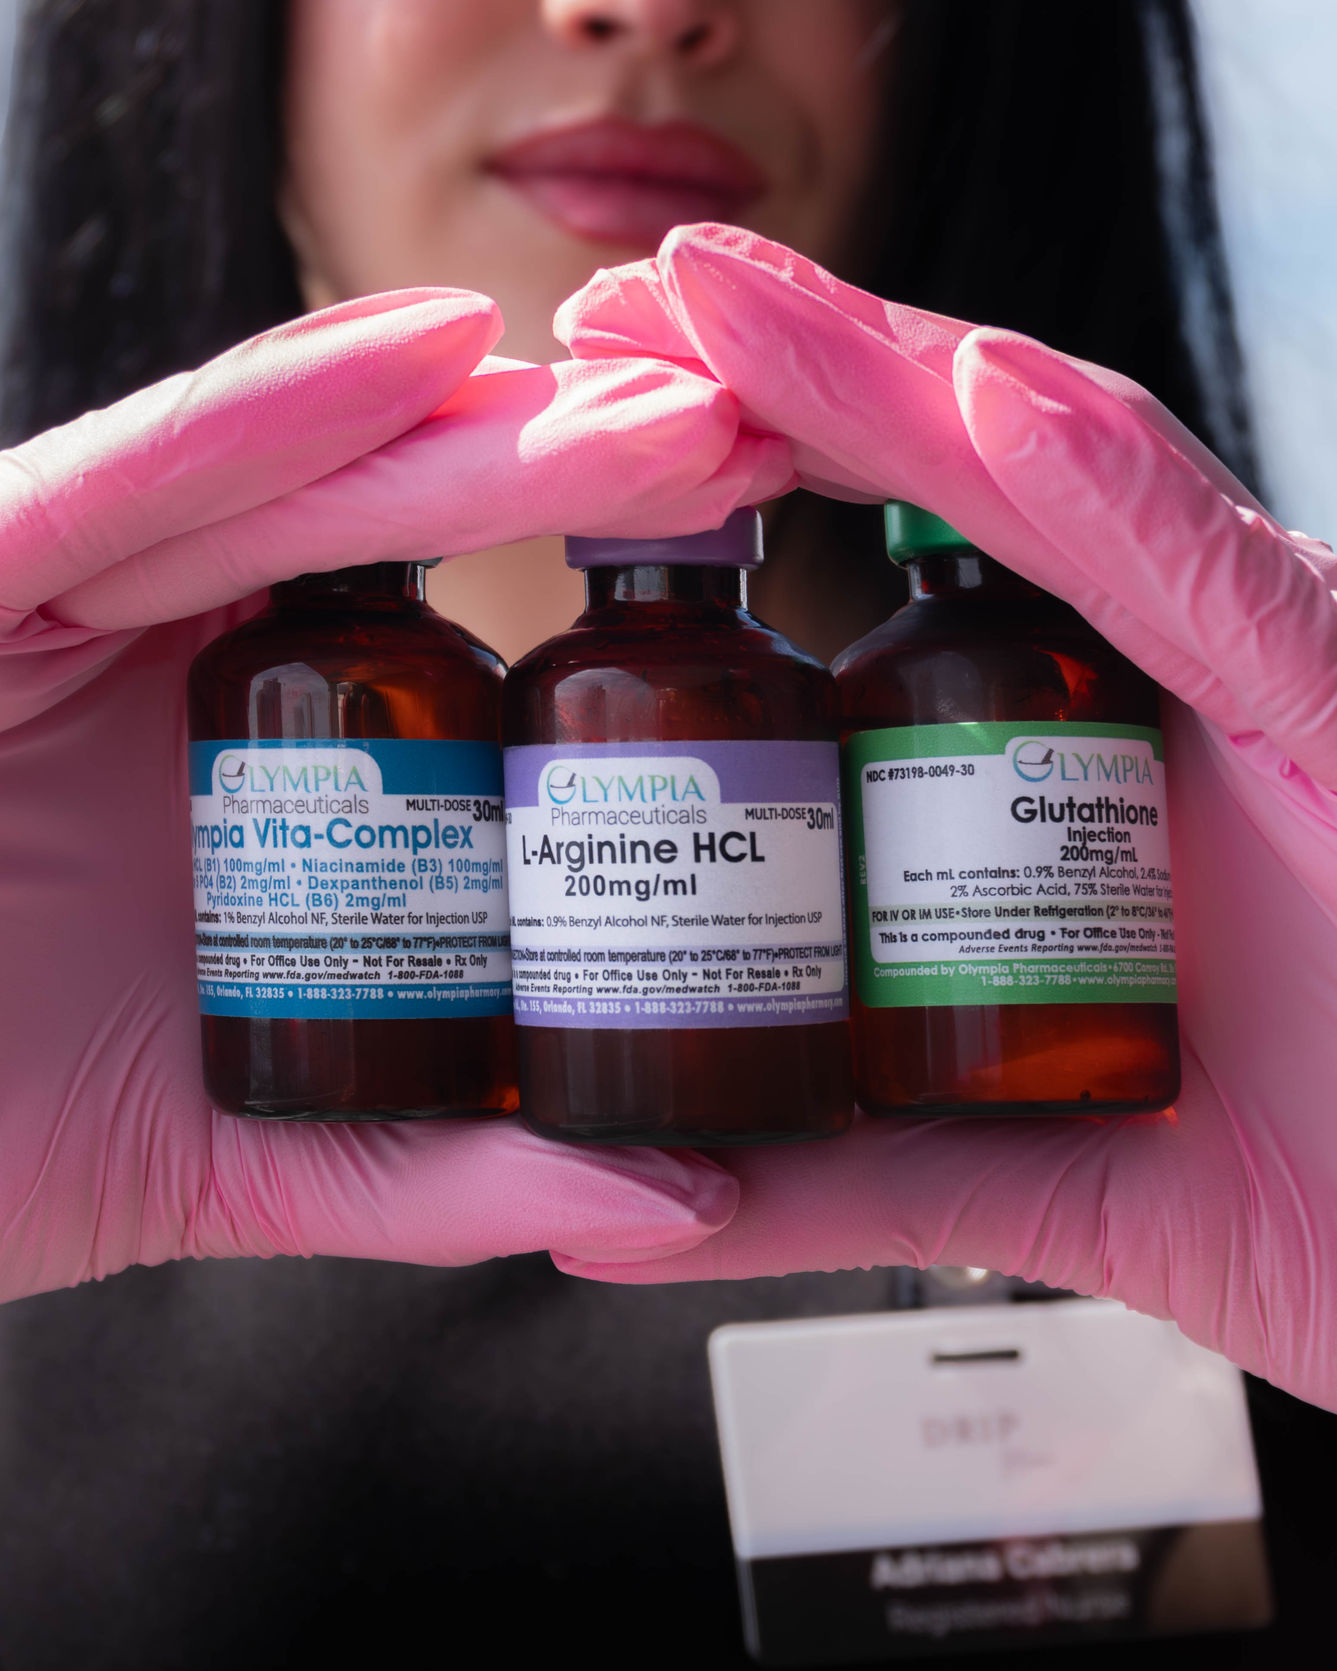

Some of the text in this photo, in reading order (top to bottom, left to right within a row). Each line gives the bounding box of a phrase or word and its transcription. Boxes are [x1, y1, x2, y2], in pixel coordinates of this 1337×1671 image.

[1012, 740, 1154, 785] OLYMPIA
[219, 754, 369, 794] OLYMPIA
[866, 764, 975, 783] NDC #73198-0049-30
[546, 766, 706, 805] OLYMPIA
[223, 794, 369, 814] Pharmaceuticals
[406, 799, 471, 812] MULTI-DOSE
[472, 799, 504, 822] 30ml
[1010, 796, 1158, 826] Glutathione
[551, 804, 707, 826] Pharmaceuticals
[745, 807, 835, 830] MULTI-DOSE 30ml
[191, 817, 474, 856] ympia Vita-Complex
[1067, 826, 1131, 846] Injection
[522, 831, 766, 873] L-Arginine HCL
[1060, 845, 1138, 865] 200mg/mL
[204, 857, 503, 876] (B1) 100mg/ml Niacinamide (B3) 100mg/ml
[903, 865, 1156, 882] Each mL contains: 0.9% Benzyl Alcohol, 2.4%
[216, 875, 503, 893] (B2) 2mg/ml Dexpanthenol (B5) 2mg/ml
[564, 873, 697, 901] 200mg/ml
[950, 883, 1155, 898] 2% Ascorbic Acid, 75% Sterile Water
[206, 891, 406, 911] Pyridoxine HCL (B6) 2mg/ml
[223, 911, 488, 928] 1% Benzyl Alcohol NF, Sterile Water for Injection USP
[517, 916, 544, 927] contains:
[546, 915, 567, 927] 0.9%
[569, 915, 602, 930] Benzyl
[604, 915, 648, 927] Alcohol
[651, 915, 669, 928] NF,
[671, 914, 709, 927] Sterile
[710, 914, 745, 926] Water
[747, 913, 763, 926] for
[765, 913, 806, 928] Injection
[807, 911, 822, 924] USP
[872, 910, 888, 922] FOR
[889, 909, 899, 921] IV
[901, 909, 916, 921] OR
[919, 908, 932, 920] IM
[994, 906, 1030, 918] Under
[1033, 905, 1104, 919] Refrigeration
[1106, 904, 1119, 920] (2°
[1121, 905, 1130, 917] to
[219, 933, 249, 948] controlled
[250, 937, 271, 949] room
[272, 935, 327, 951] temperature
[350, 937, 359, 949] to
[402, 937, 411, 949] to
[878, 931, 897, 944] This
[899, 931, 908, 943] is
[910, 932, 918, 942] a
[921, 928, 1010, 943] compounded
[1014, 928, 1045, 942] drug
[1060, 927, 1080, 939] For
[1083, 927, 1117, 939] Office
[1119, 927, 1136, 939] Use
[1138, 928, 1156, 942] Only
[546, 949, 581, 962] controlled
[583, 951, 606, 962] room
[608, 949, 666, 965] temperature
[689, 950, 699, 962] to
[742, 949, 751, 961] to
[813, 945, 830, 958] FROM
[958, 944, 995, 954] Adverse
[998, 943, 1028, 954] Events
[1031, 943, 1075, 954] Reporting
[1077, 942, 1157, 954] www.fda.gov/medwatch
[225, 954, 488, 969] drug For Office Use Only Not For Resale Rx Only
[873, 964, 938, 978] Compounded
[940, 964, 955, 977] by
[958, 963, 1010, 977] Olympia
[1135, 962, 1160, 975] Conroy
[224, 968, 464, 982] Reporting www.fda.gov/medwatch 1-800-FDA-1088
[518, 969, 551, 982] compounded
[553, 969, 571, 983] drug
[583, 969, 599, 981] For
[602, 969, 633, 981] Office
[637, 969, 658, 981] Use
[662, 969, 688, 983] Only
[702, 968, 722, 980] Not
[726, 967, 743, 980] For
[747, 966, 781, 980] Resale
[792, 965, 803, 978] Rx
[806, 965, 822, 979] Only
[216, 985, 243, 1000] Orlando,
[245, 987, 254, 999] FL
[255, 988, 285, 999] 32835
[297, 988, 384, 999] 1-888-323-7788
[530, 981, 801, 996] Events Reporting www.fda.gov/medwatch 1-800-FDA-1088
[543, 1000, 724, 1016] Orlando, FL 32835 1-888-323-7788
[921, 1413, 1020, 1449] DRIP
[870, 1548, 1002, 1591] Adriana
